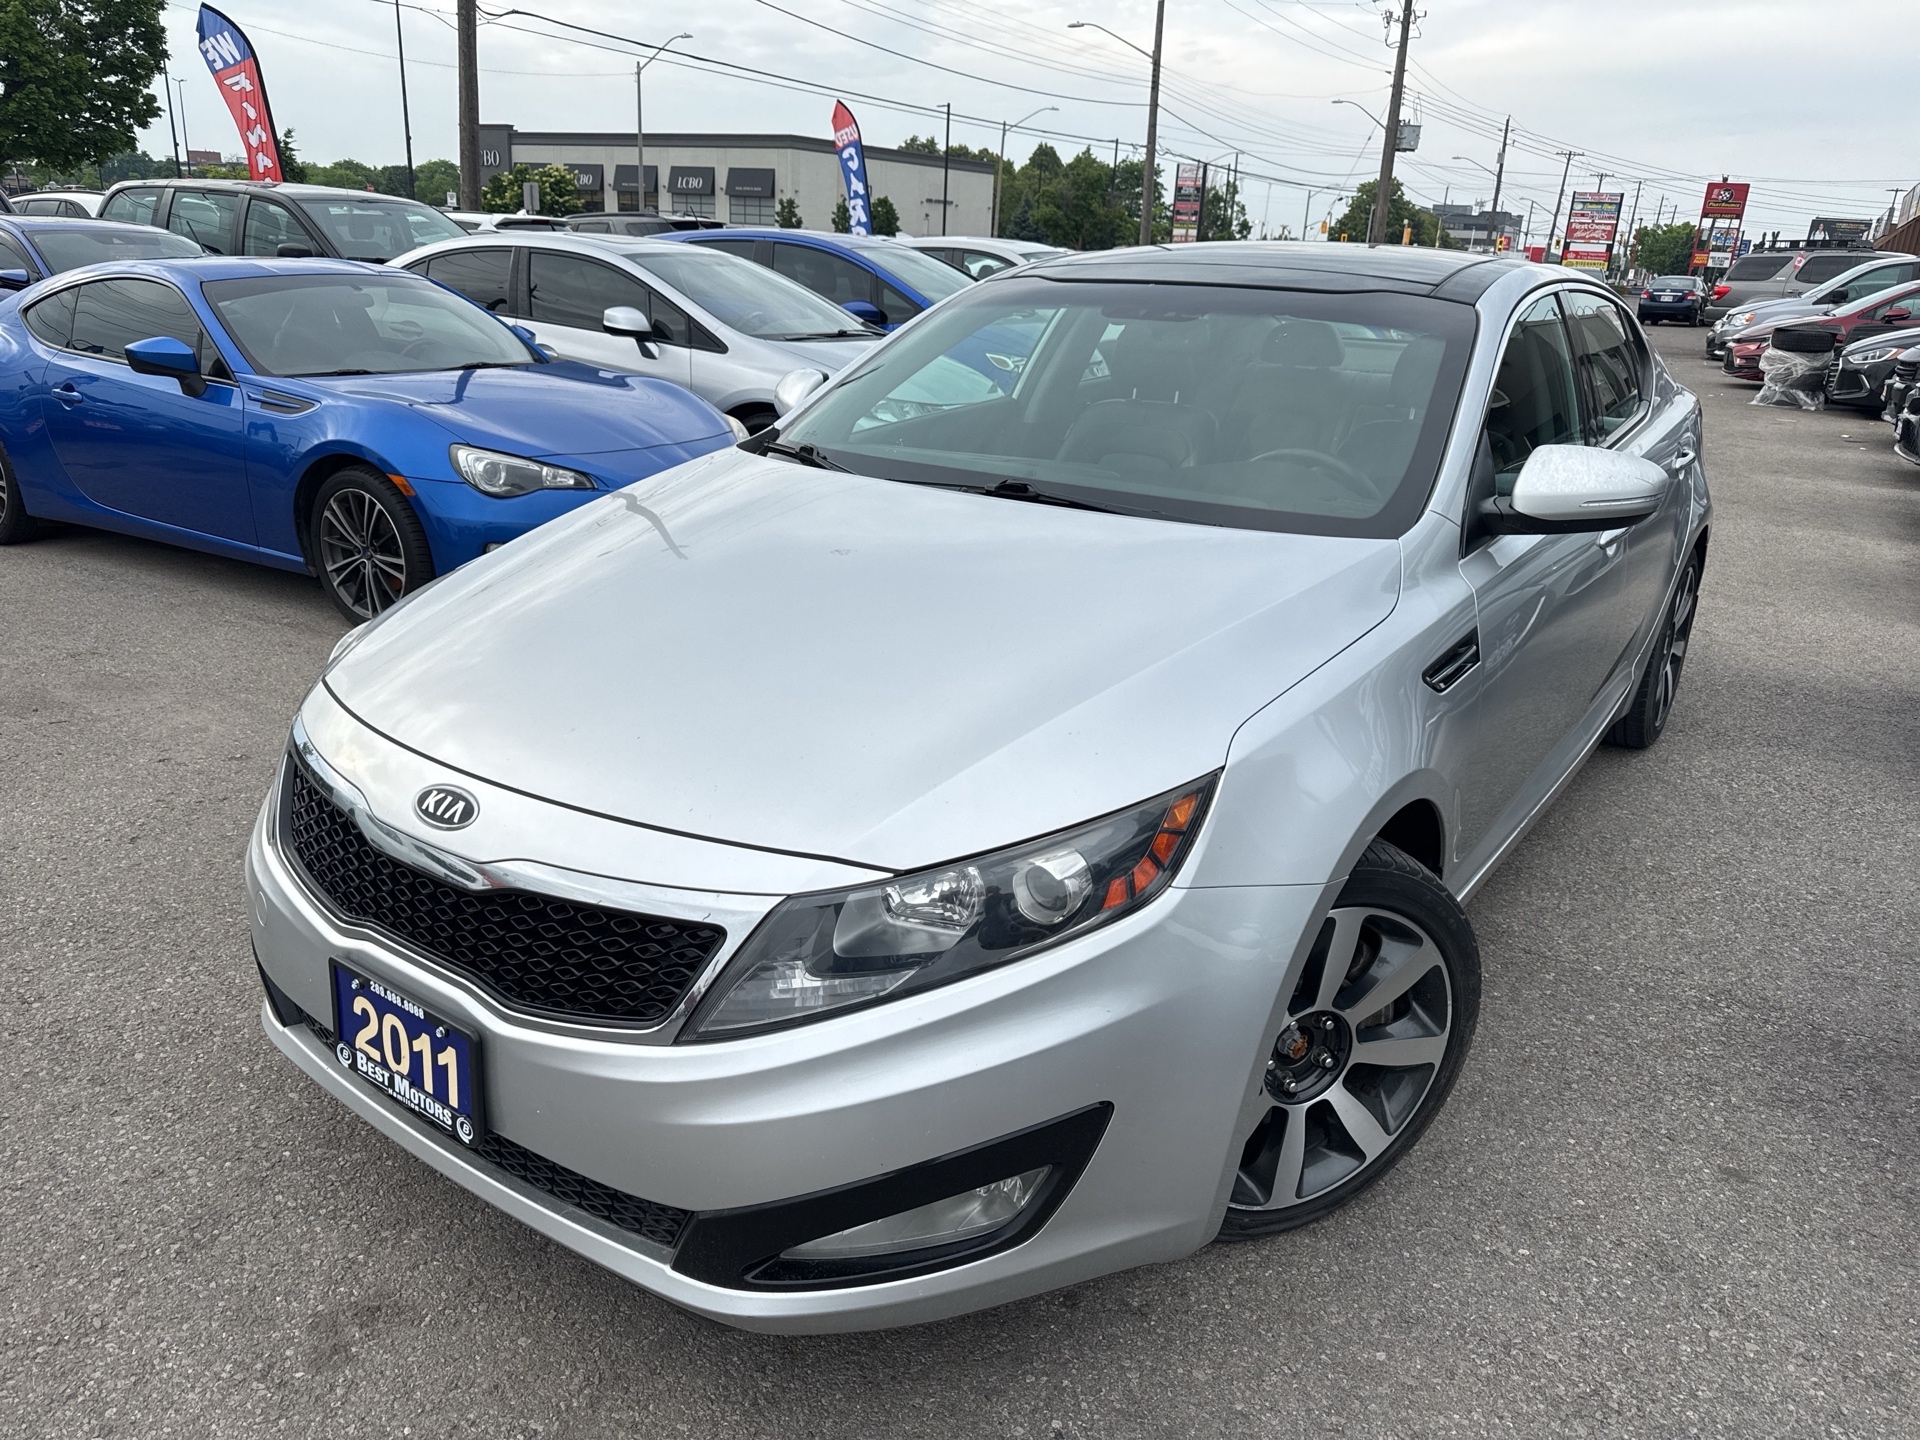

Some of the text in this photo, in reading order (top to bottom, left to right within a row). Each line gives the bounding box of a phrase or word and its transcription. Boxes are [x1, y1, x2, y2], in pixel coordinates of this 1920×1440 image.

[677, 176, 703, 189] LCBO
[1588, 223, 1612, 231] Choice
[421, 790, 466, 823] KIA
[353, 996, 459, 1109] 2011
[356, 1051, 453, 1126] BEST MOTORS
